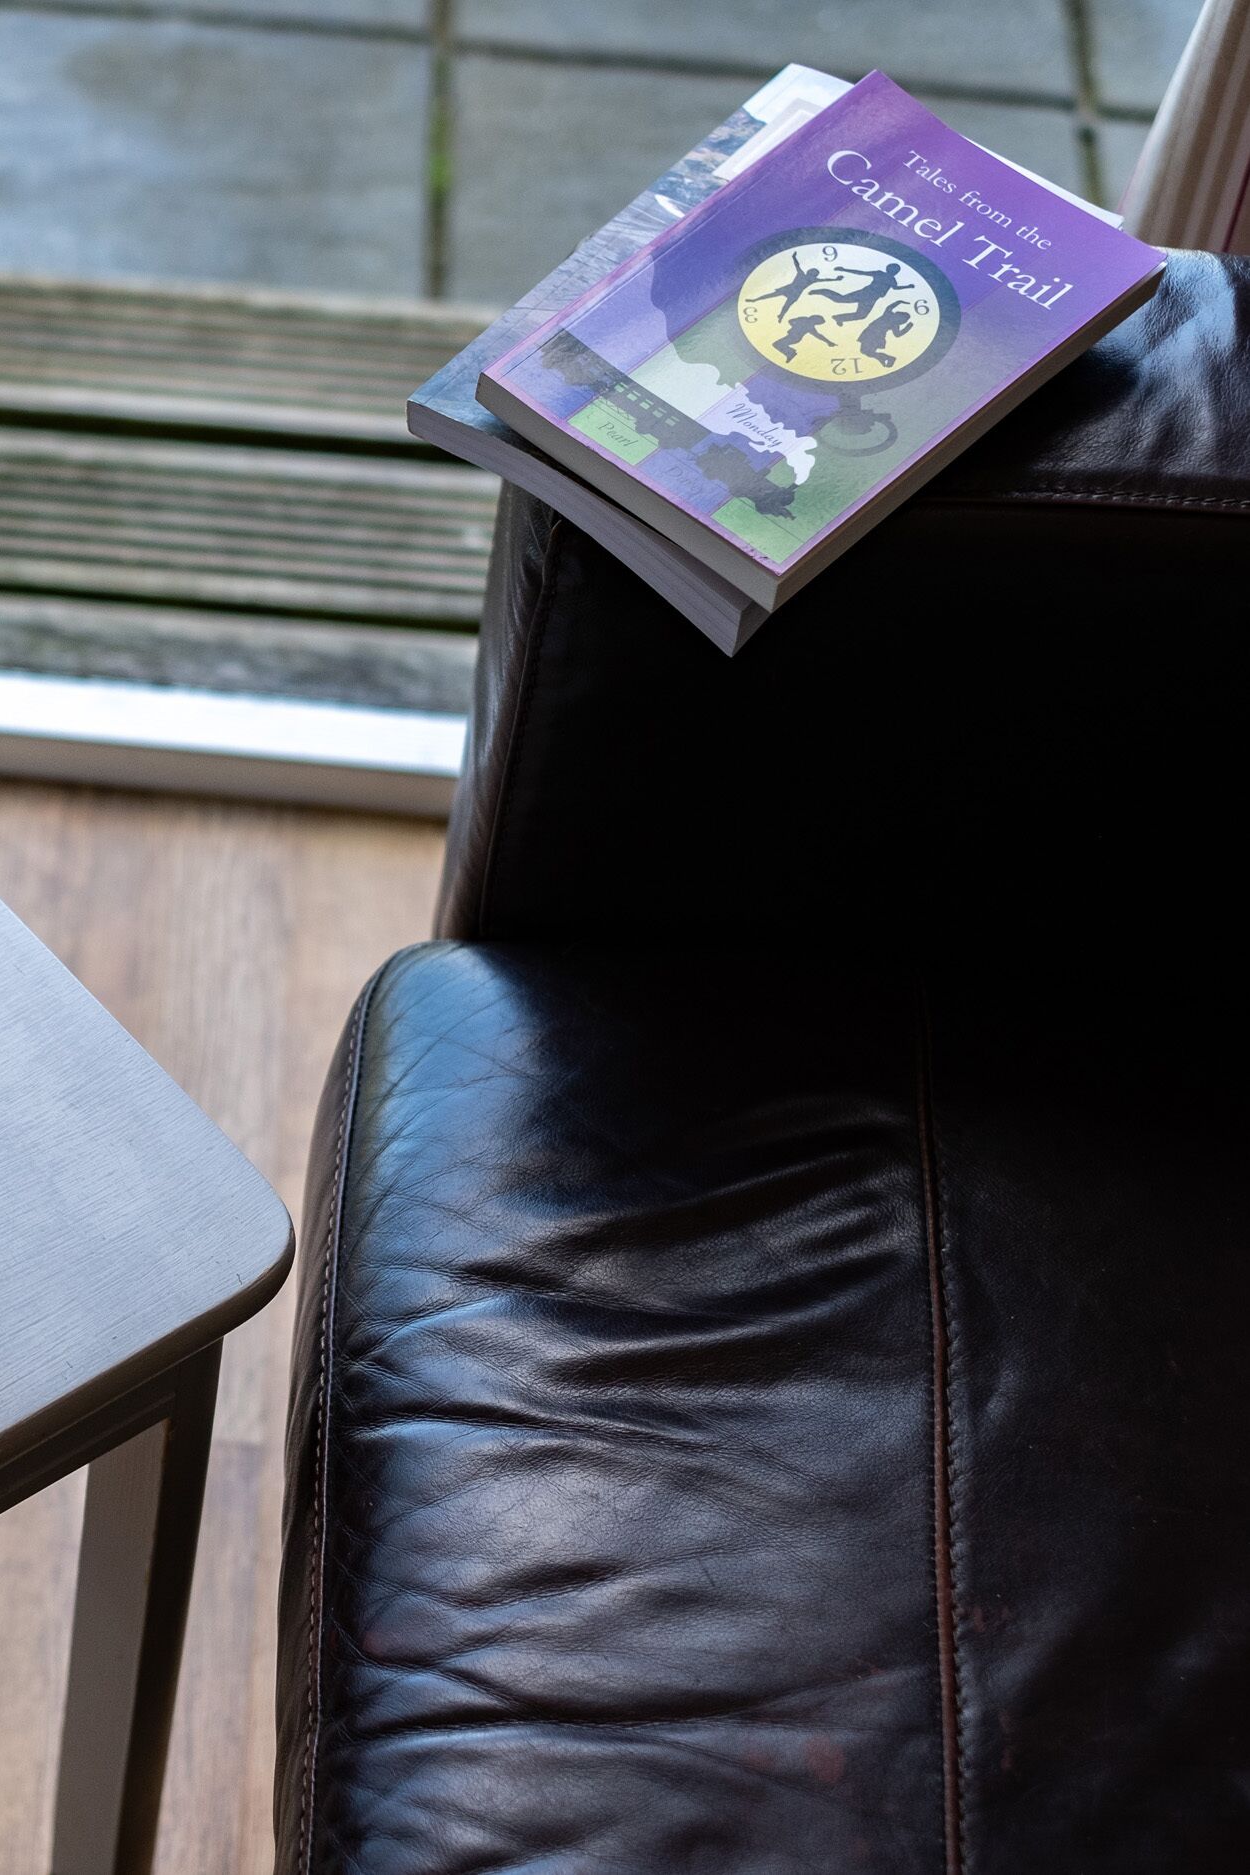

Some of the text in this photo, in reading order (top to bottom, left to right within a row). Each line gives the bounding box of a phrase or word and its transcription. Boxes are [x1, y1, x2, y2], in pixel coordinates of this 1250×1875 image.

[903, 150, 1052, 250] Tales from the
[827, 150, 1073, 311] Camel Trail
[830, 357, 863, 376] 12
[597, 421, 639, 448] Pearl
[725, 403, 783, 449] Monday
